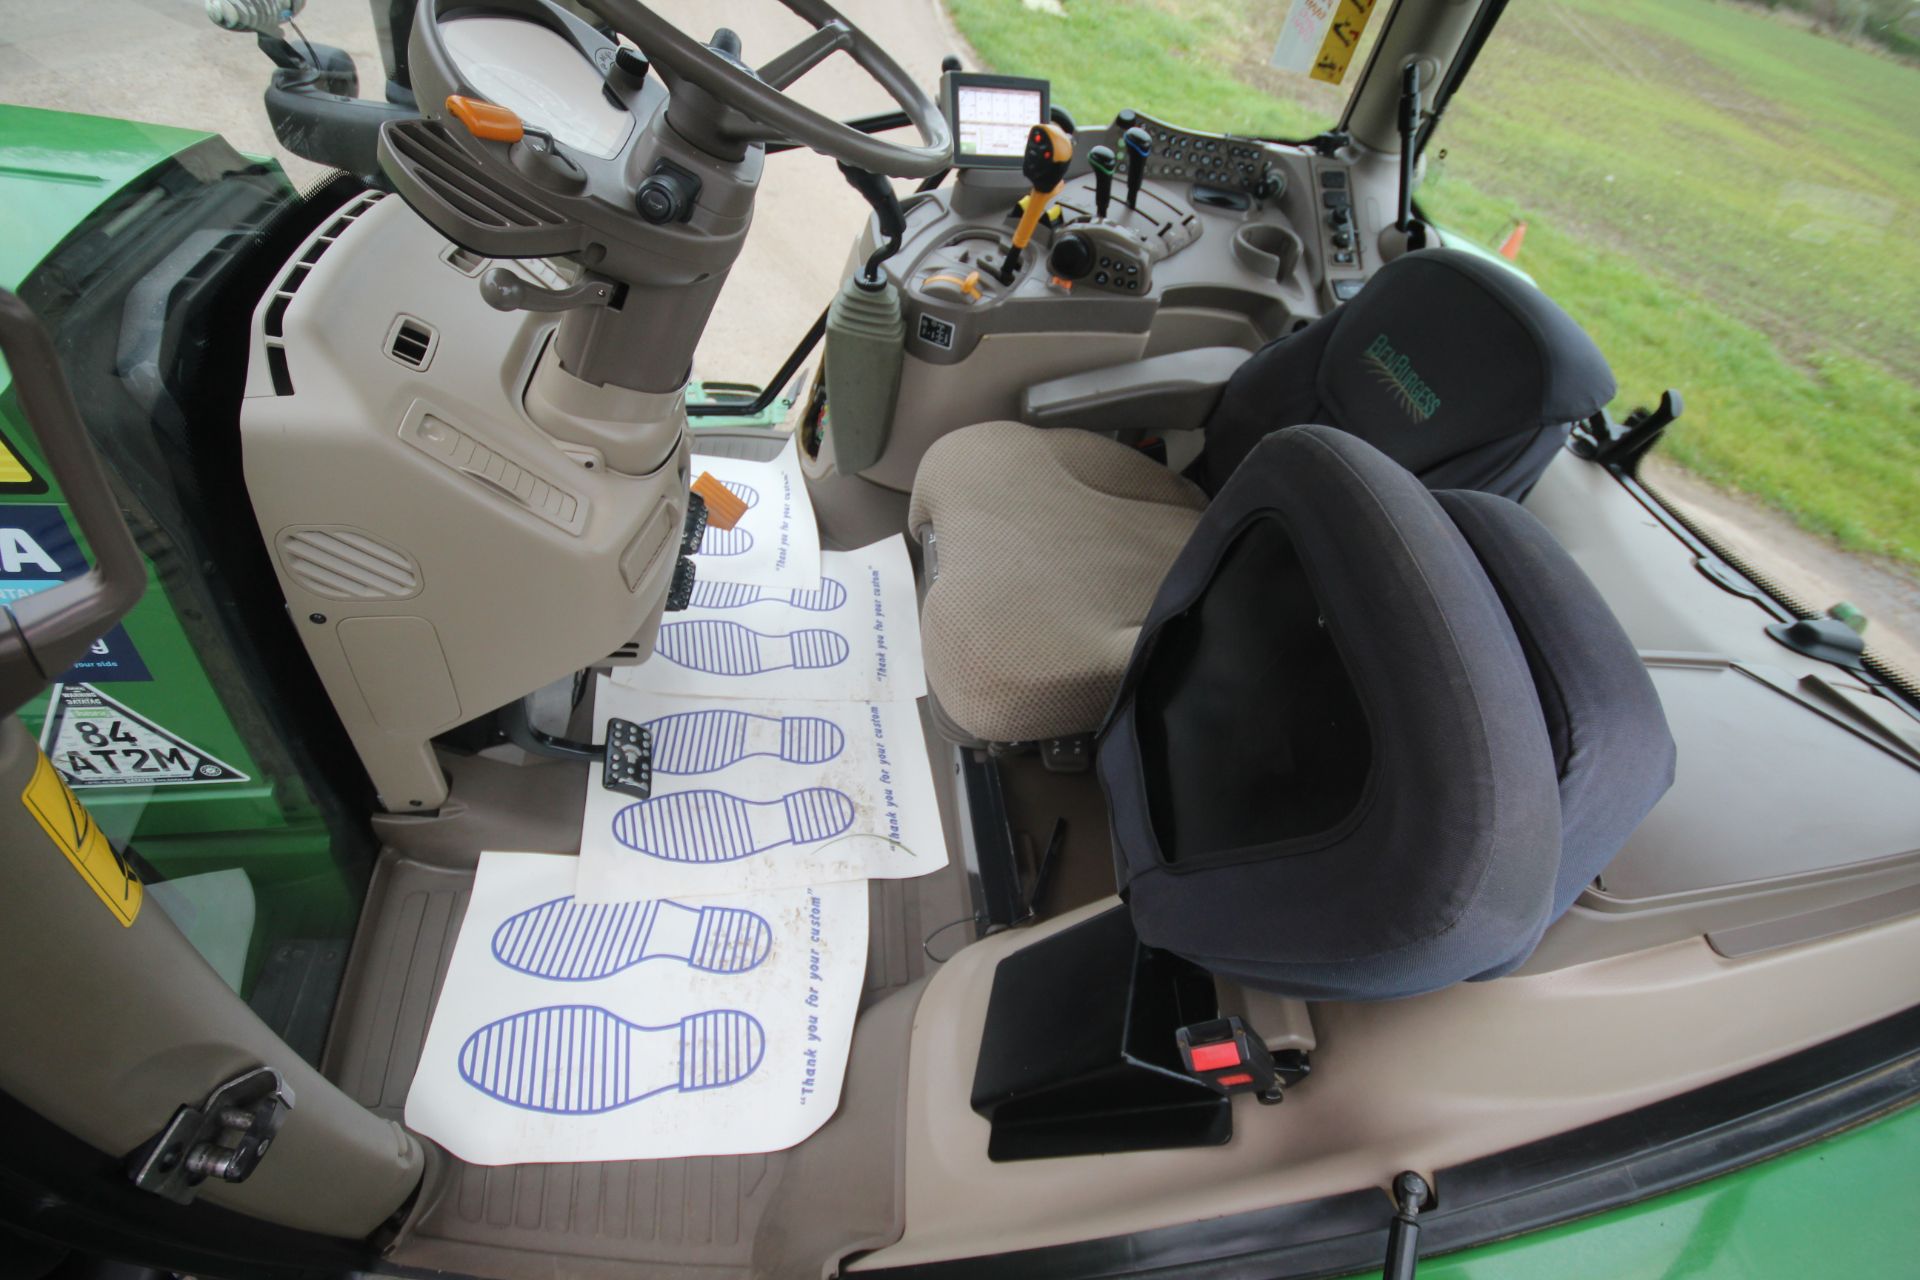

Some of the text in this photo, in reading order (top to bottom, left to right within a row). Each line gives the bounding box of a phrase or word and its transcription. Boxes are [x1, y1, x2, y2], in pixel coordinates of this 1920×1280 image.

[0, 528, 62, 572] A
[874, 600, 885, 617] your
[873, 620, 884, 631] for
[877, 634, 888, 650] you
[865, 700, 883, 738] custom"
[75, 721, 138, 747] 84
[66, 748, 191, 774] AT2M
[876, 743, 891, 765] your
[879, 769, 891, 784] for
[884, 788, 898, 808] you
[800, 888, 823, 1105] "Thank you for your custom"
